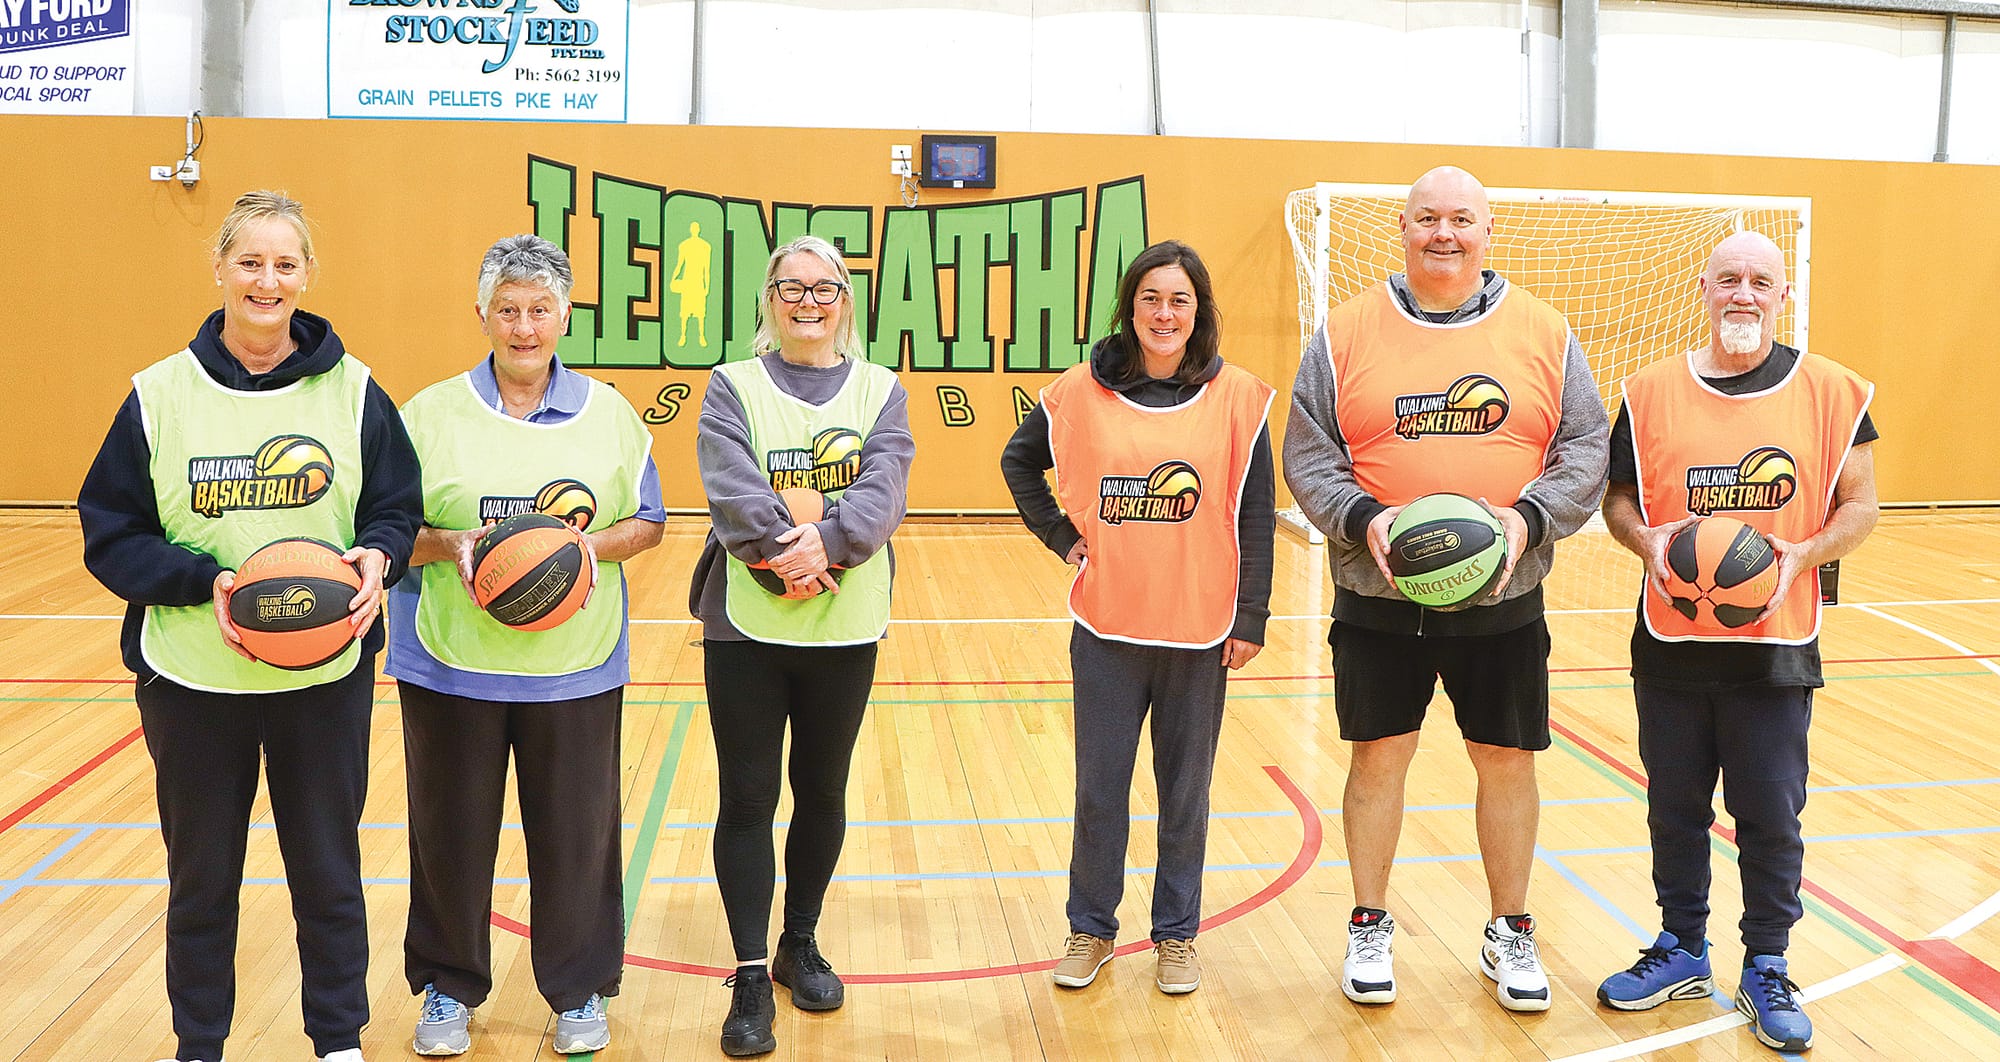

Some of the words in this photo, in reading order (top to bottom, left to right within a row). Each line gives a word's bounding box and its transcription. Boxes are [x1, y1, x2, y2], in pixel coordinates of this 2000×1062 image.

[0, 28, 49, 45] UNK
[57, 19, 108, 38] DEAL
[29, 66, 48, 80] TO
[53, 66, 126, 81] SUPPORT
[515, 68, 540, 81] Ph:
[545, 69, 580, 82] 5662
[586, 69, 621, 82] 3199
[0, 86, 32, 101] CAL
[38, 87, 92, 102] SPORT
[358, 88, 414, 106] GRAIN
[429, 90, 503, 107] PELLETS
[515, 92, 551, 109] PKE
[564, 92, 598, 109] HAY
[1398, 396, 1446, 415] WALKING
[1399, 411, 1486, 438] BASKETBALL
[192, 458, 254, 482] WALKING
[773, 461, 852, 493] BASKETBALL
[1689, 468, 1738, 487] WALKING
[195, 476, 306, 515] BASKETBALL
[1101, 479, 1147, 497] WALKING
[1691, 484, 1779, 514] BASKETBALL
[483, 499, 535, 518] WALKING
[1103, 496, 1183, 522] BASKETBALL
[241, 545, 337, 580] SPALDING
[478, 534, 549, 597] SPALDING
[1405, 558, 1485, 597] SPALDING
[260, 604, 304, 621] BASKETBALL
